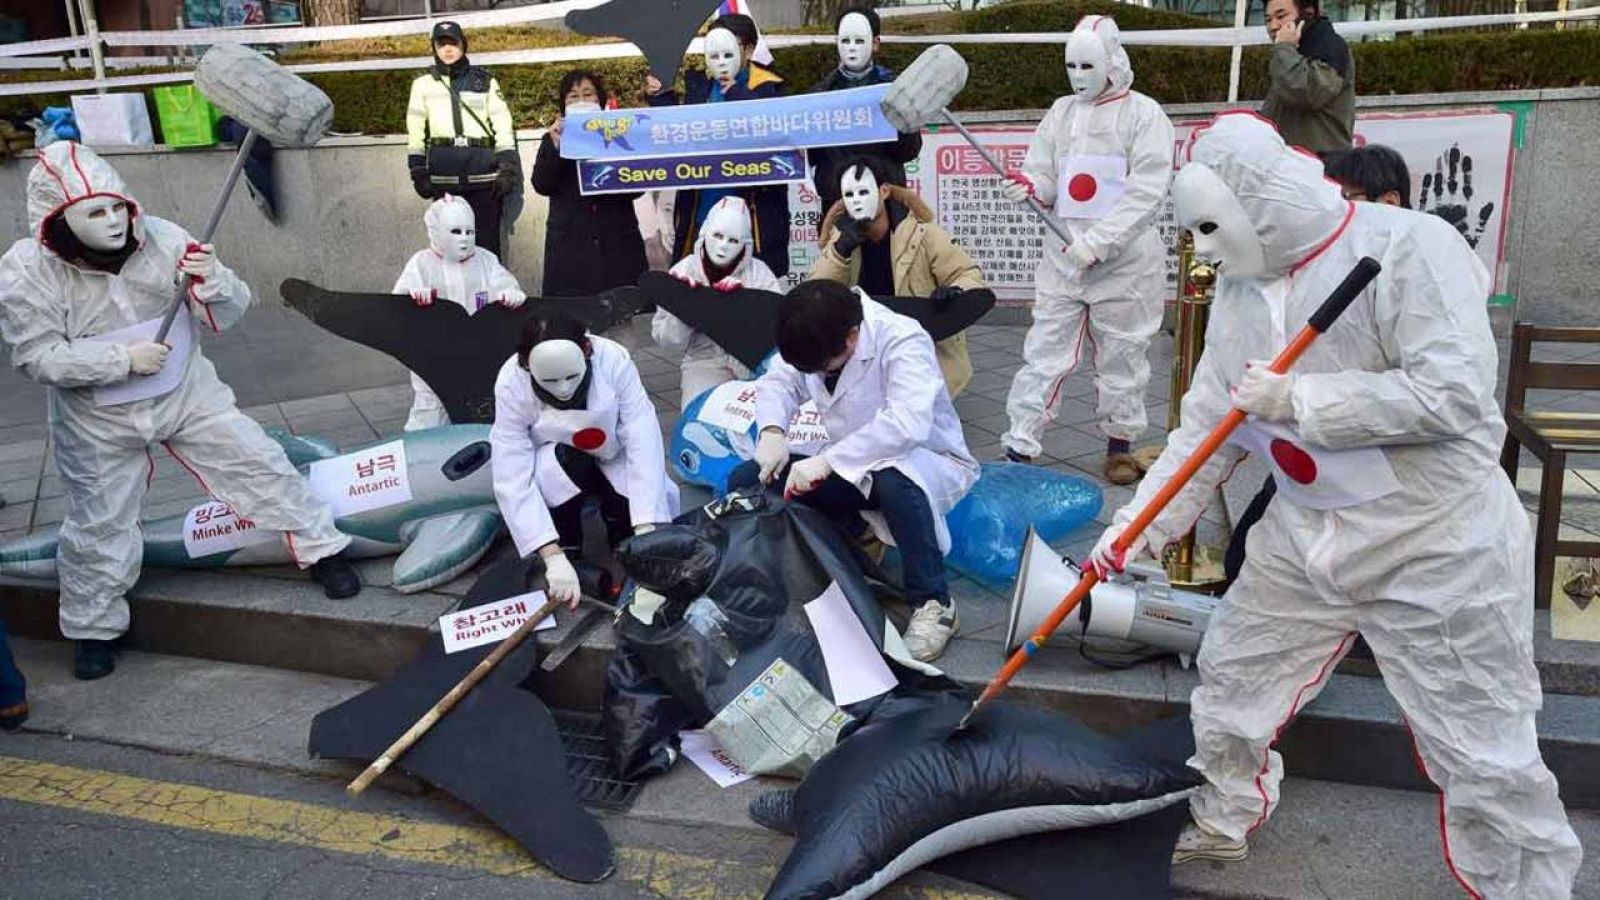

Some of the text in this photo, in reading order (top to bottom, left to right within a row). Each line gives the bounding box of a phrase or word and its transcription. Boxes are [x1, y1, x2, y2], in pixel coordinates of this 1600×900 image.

[651, 106, 873, 145] 환경운동연합바다위원회
[618, 160, 771, 184] Save Our Seas
[356, 453, 396, 478] 남극
[348, 476, 400, 497] Antartic
[194, 504, 235, 524] 밍크
[192, 517, 256, 541] Minke Wh
[453, 600, 528, 630] 참고래
[455, 617, 527, 641] Right Wh
